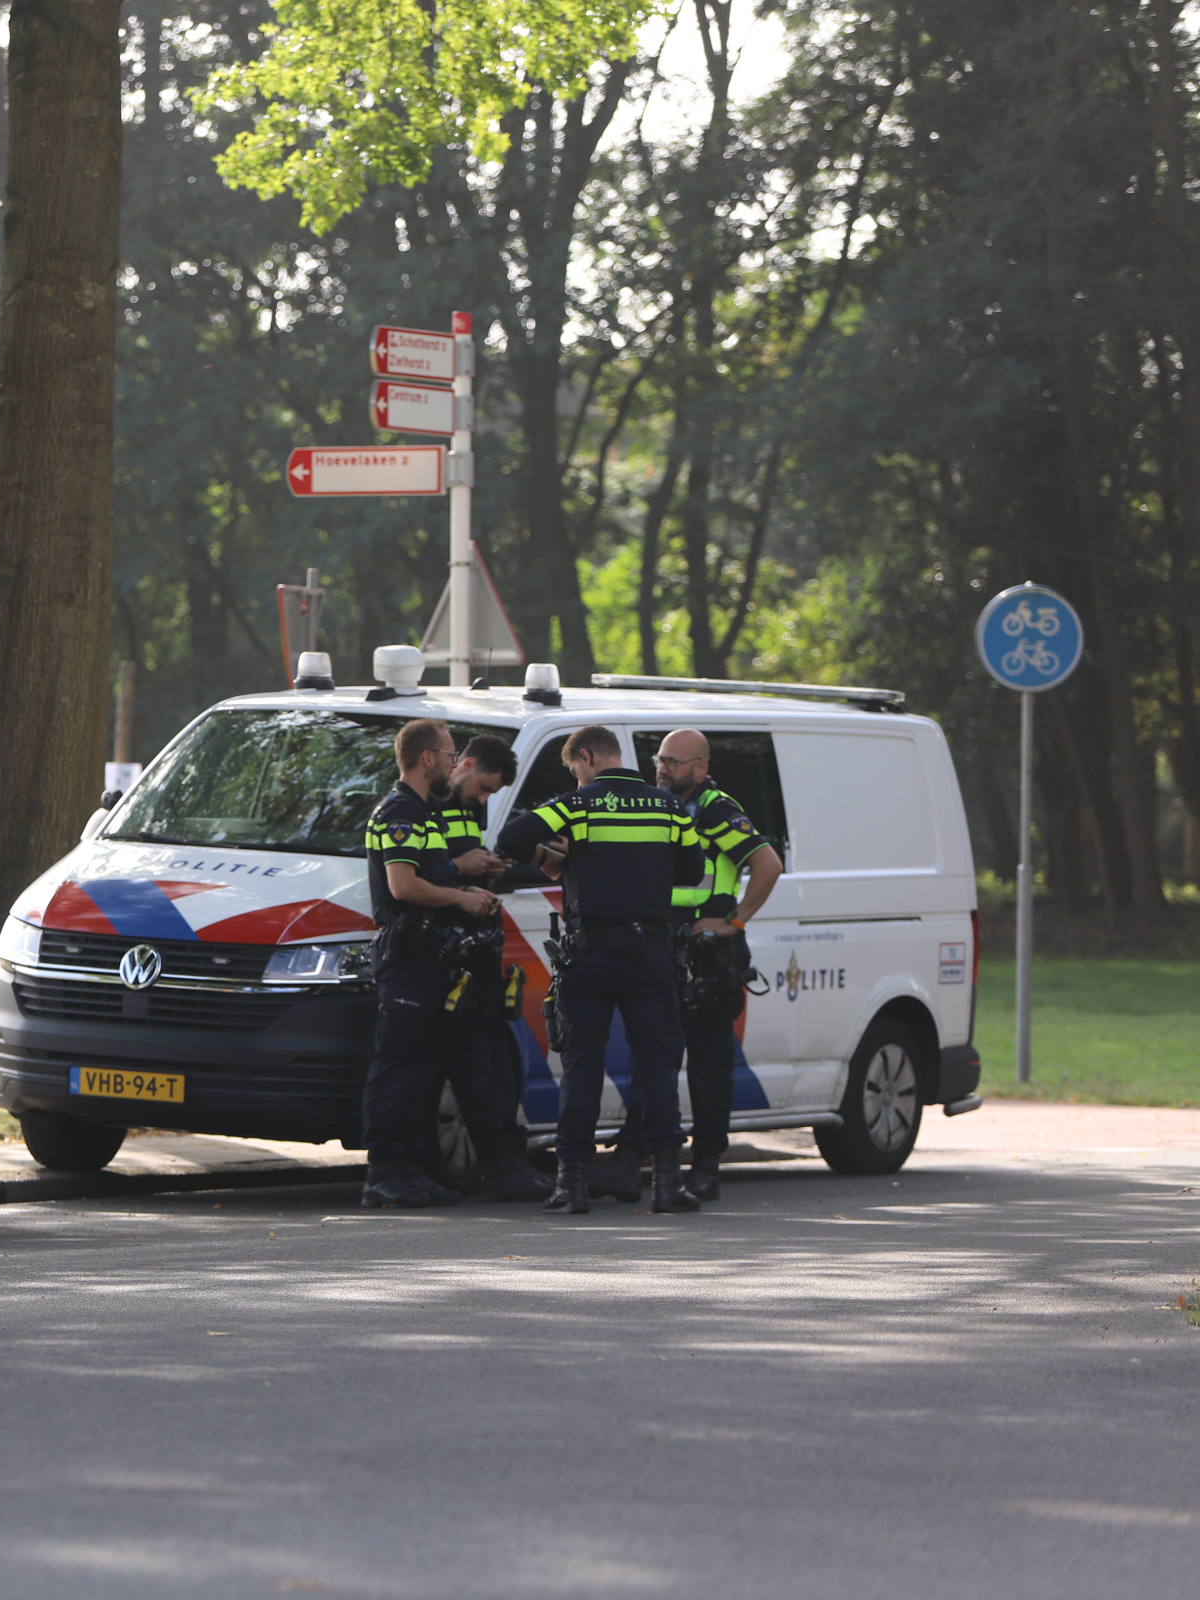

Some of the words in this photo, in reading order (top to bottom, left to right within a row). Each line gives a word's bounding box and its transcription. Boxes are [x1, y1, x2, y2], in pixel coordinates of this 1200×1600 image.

[389, 354, 425, 369] Zielhorst
[390, 388, 422, 403] Centrum
[315, 453, 397, 467] Hoevelaken
[402, 456, 409, 466] 2
[595, 797, 662, 811] POLITIE
[168, 860, 283, 878] OLITIE
[776, 968, 846, 1002] POLITIE
[85, 1071, 178, 1098] VHB-94-T
